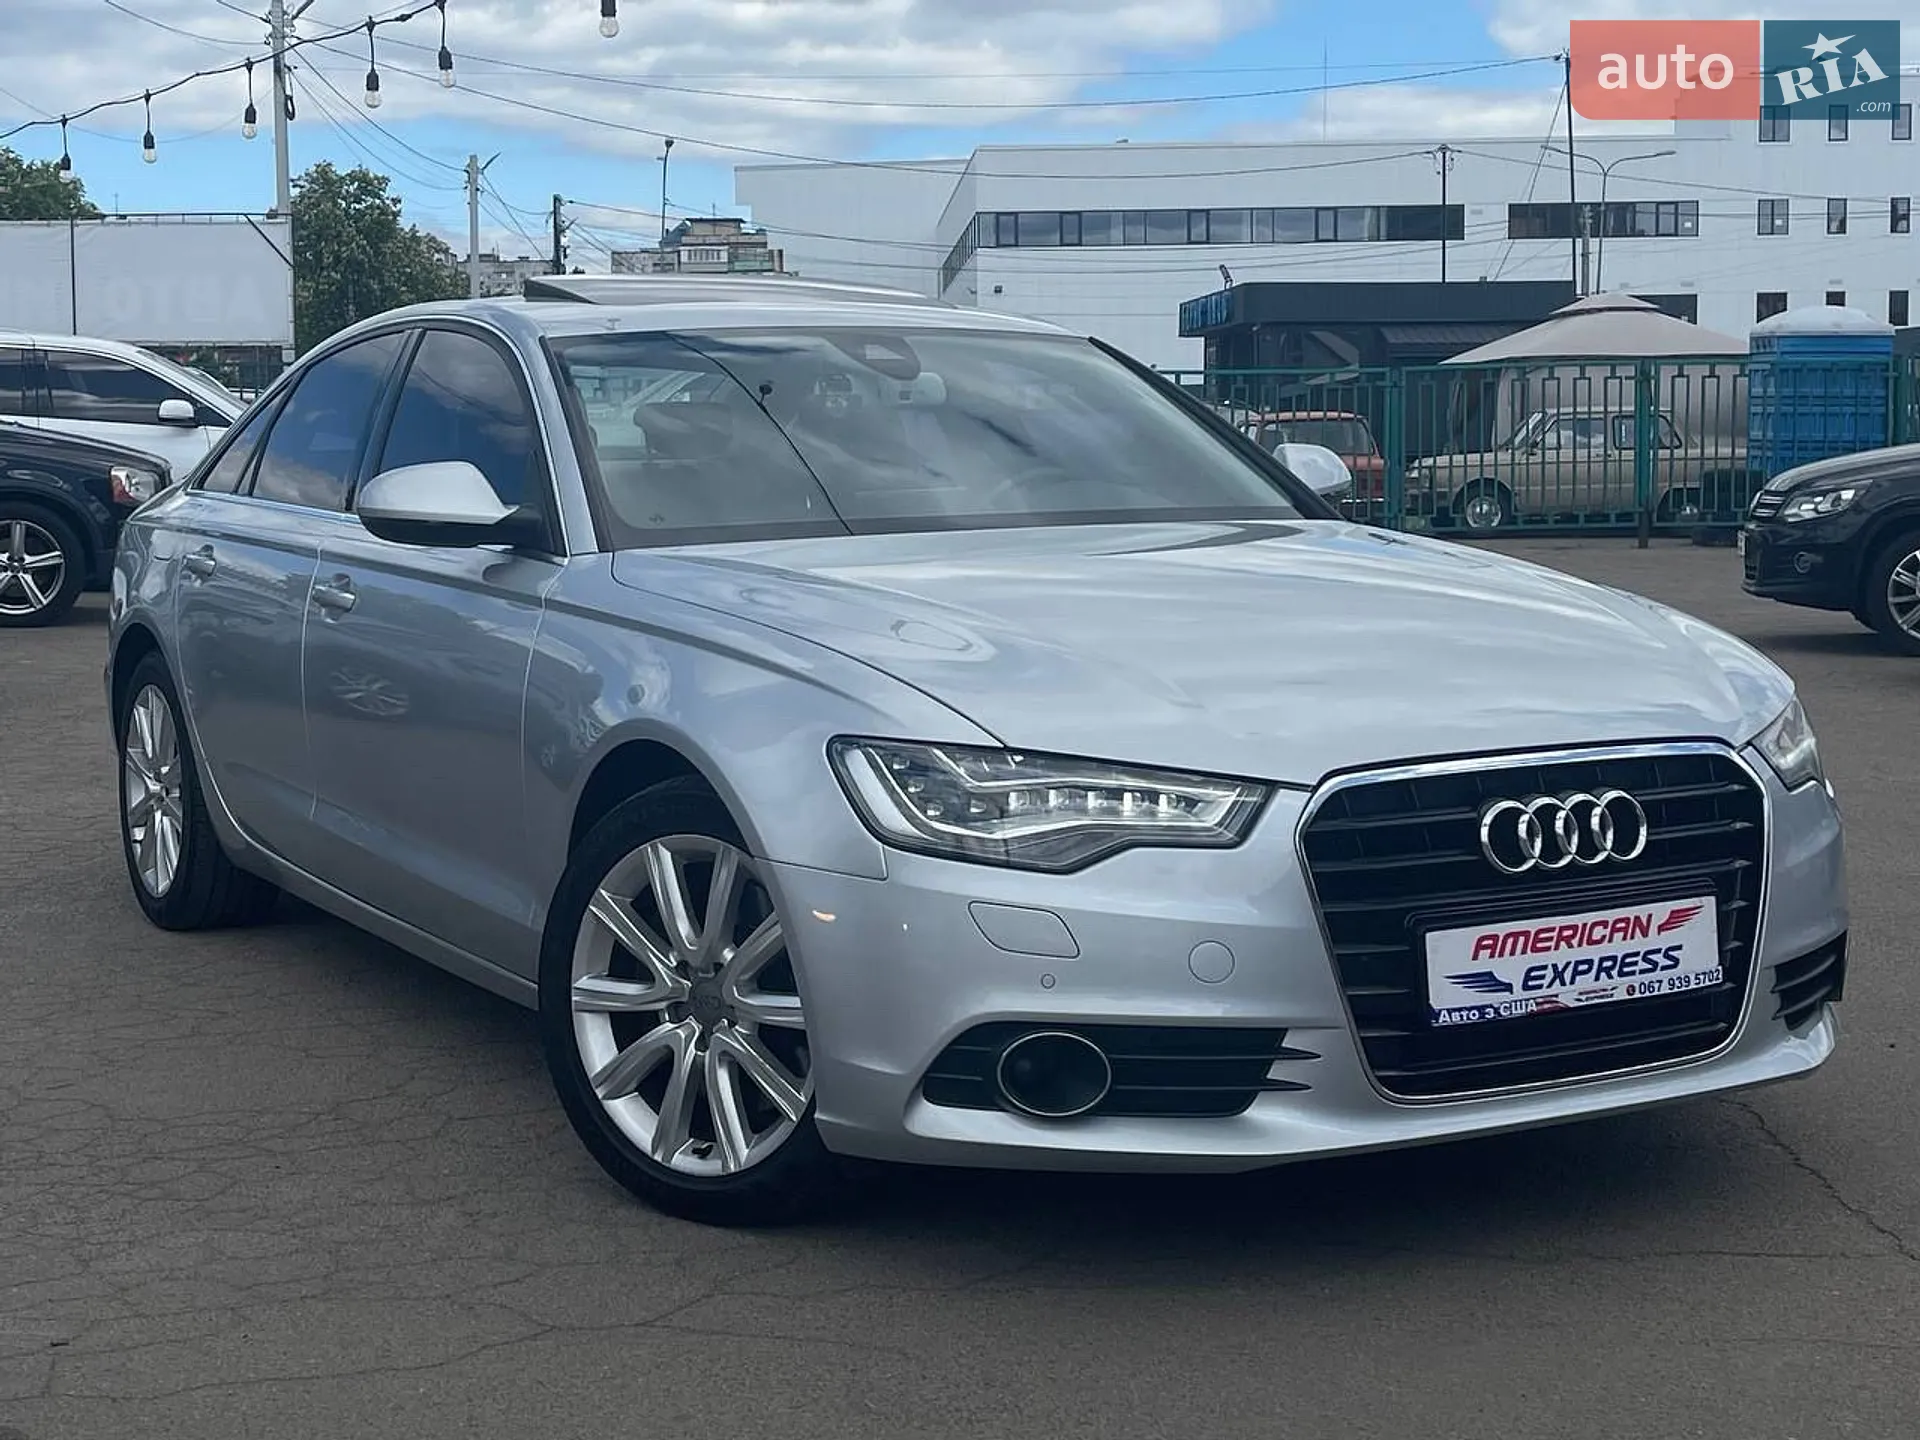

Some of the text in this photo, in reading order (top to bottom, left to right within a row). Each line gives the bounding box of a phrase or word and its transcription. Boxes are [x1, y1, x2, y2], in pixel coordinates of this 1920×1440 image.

[1471, 913, 1653, 961] AMERICAN
[1521, 944, 1683, 991] EXPRESS
[1638, 968, 1721, 996] 067 939 5702
[1438, 1008, 1480, 1024] Авто
[1500, 1000, 1537, 1016] США
